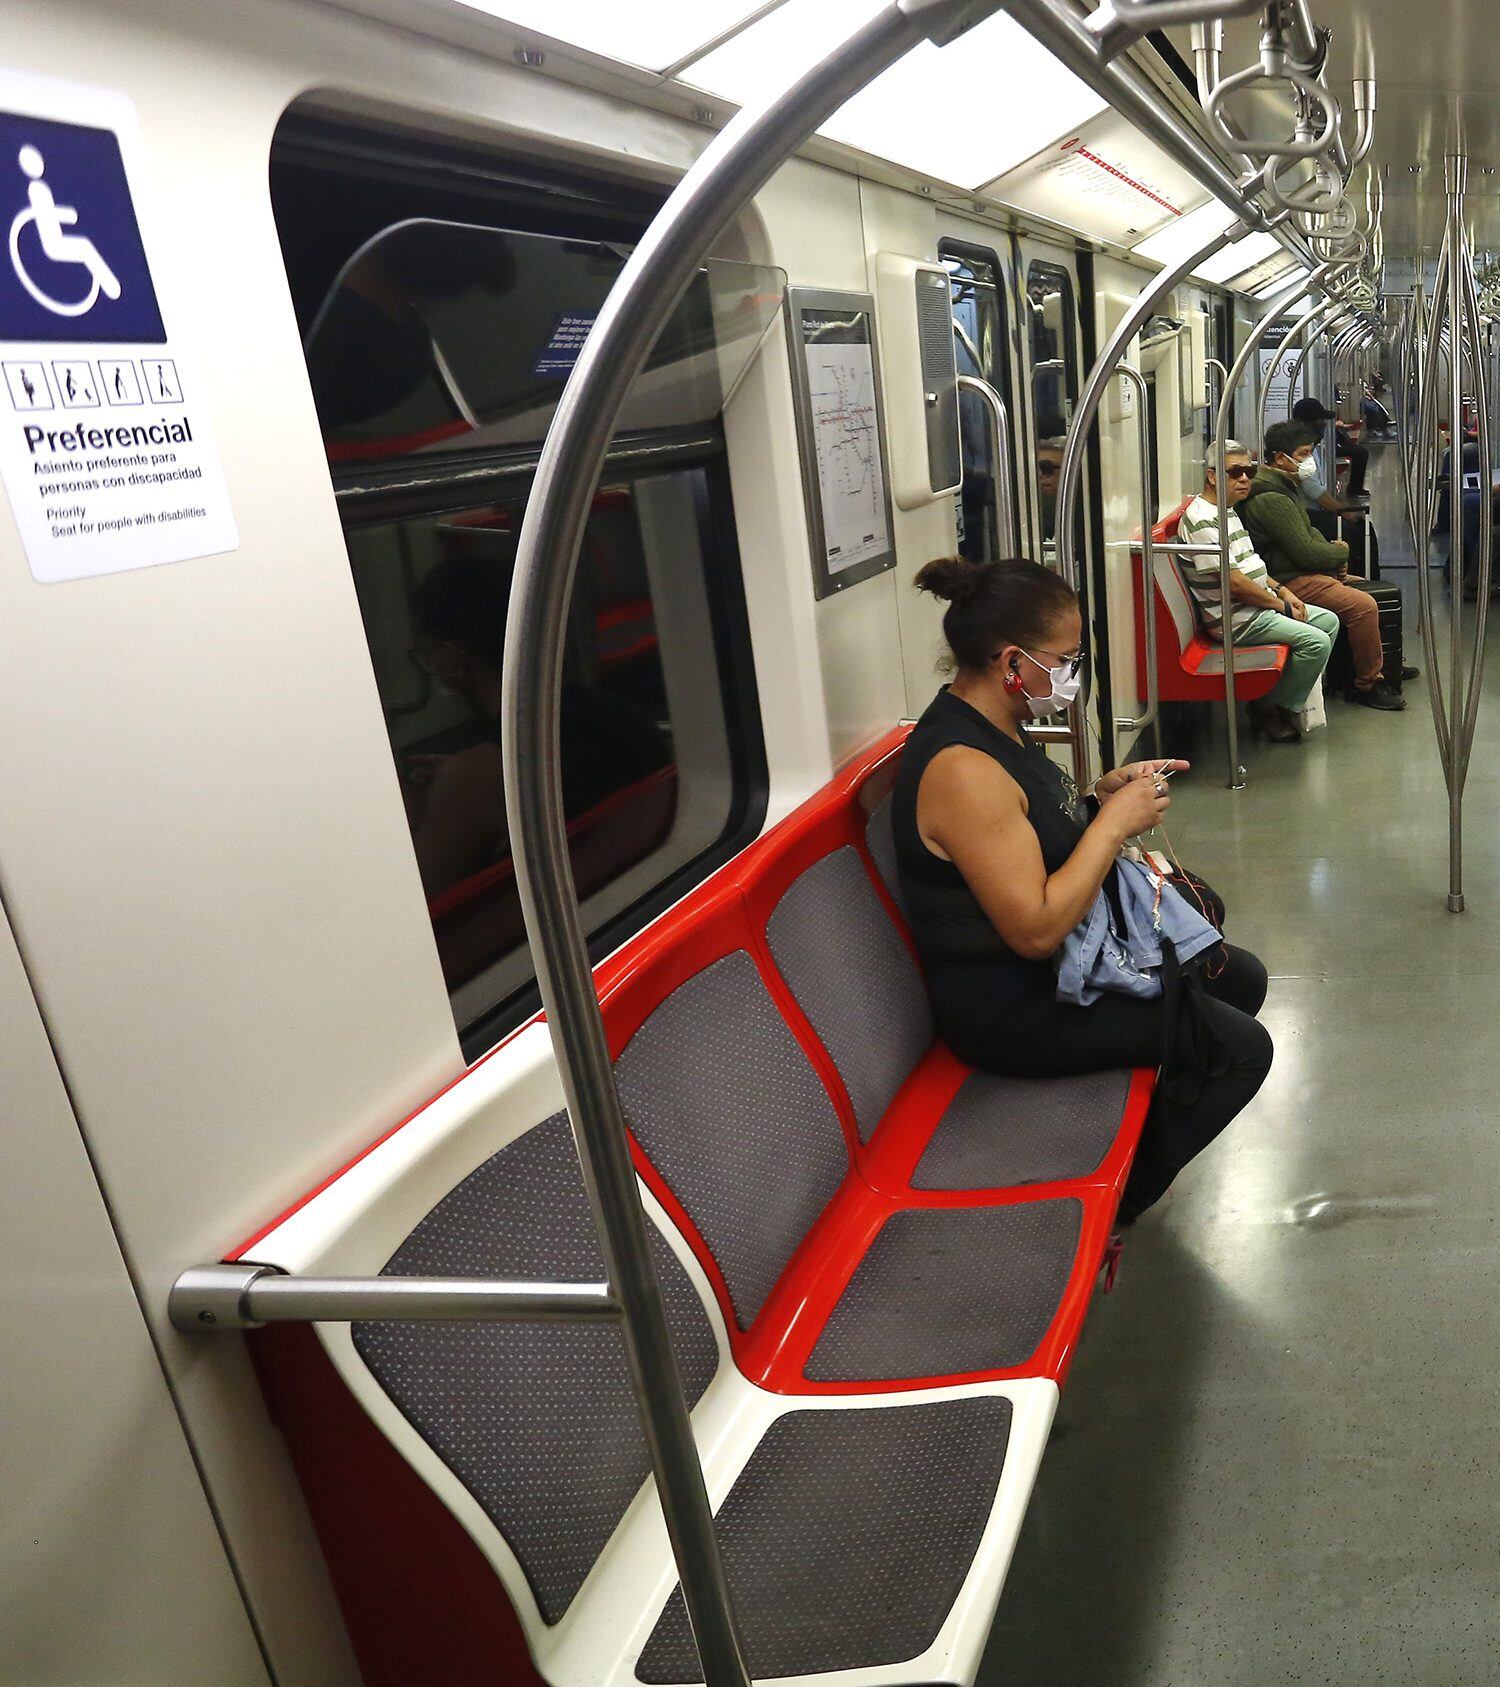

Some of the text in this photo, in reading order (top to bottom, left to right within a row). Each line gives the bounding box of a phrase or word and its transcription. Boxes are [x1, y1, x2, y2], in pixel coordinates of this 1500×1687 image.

[23, 417, 193, 454] Preferencial
[34, 453, 177, 475] Asiento preferente para
[39, 467, 202, 498] personas con discapacidad
[46, 504, 86, 520] Priority
[51, 506, 207, 538] Seat for people with disabilities
